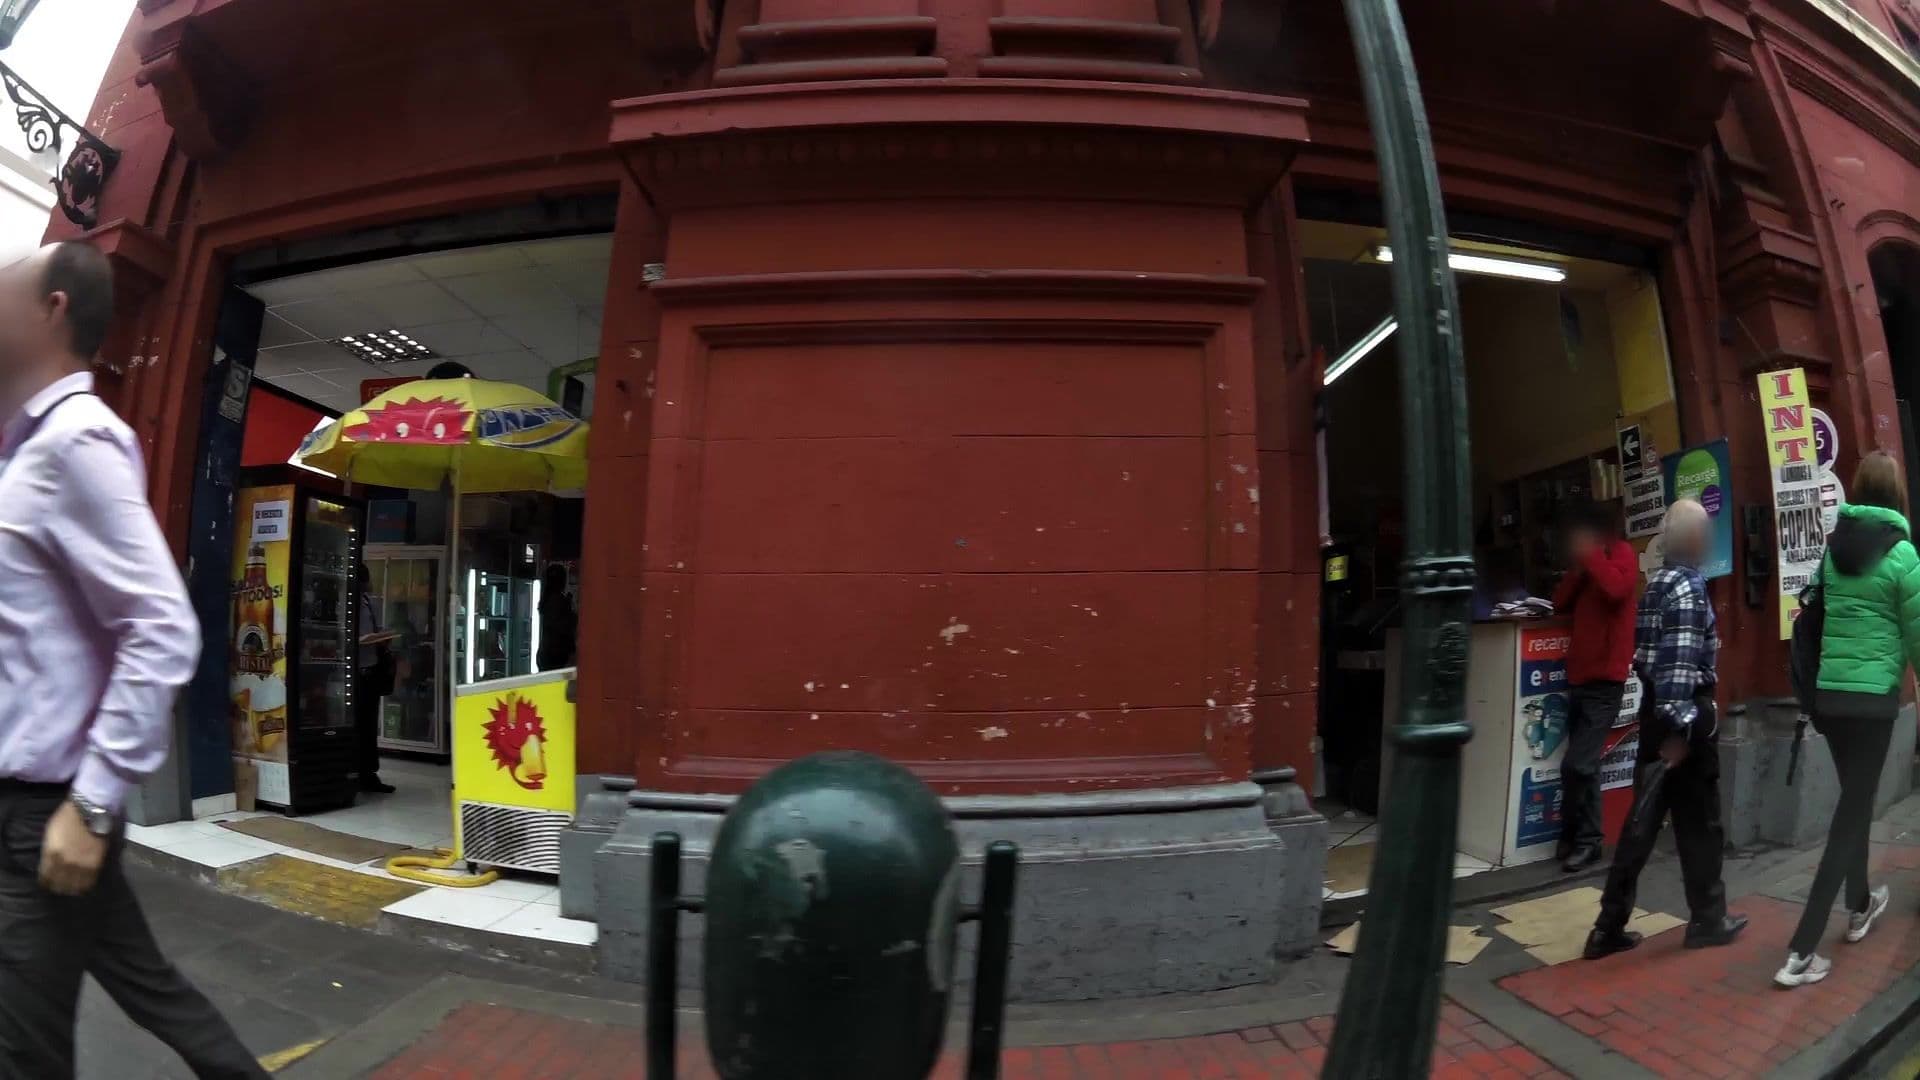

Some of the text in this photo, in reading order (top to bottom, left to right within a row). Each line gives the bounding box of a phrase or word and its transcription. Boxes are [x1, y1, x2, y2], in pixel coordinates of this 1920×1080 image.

[1677, 468, 1718, 486] Recarga
[1779, 507, 1824, 550] COPIAS
[1528, 636, 1570, 653] recarg
[1548, 669, 1568, 682] ent
